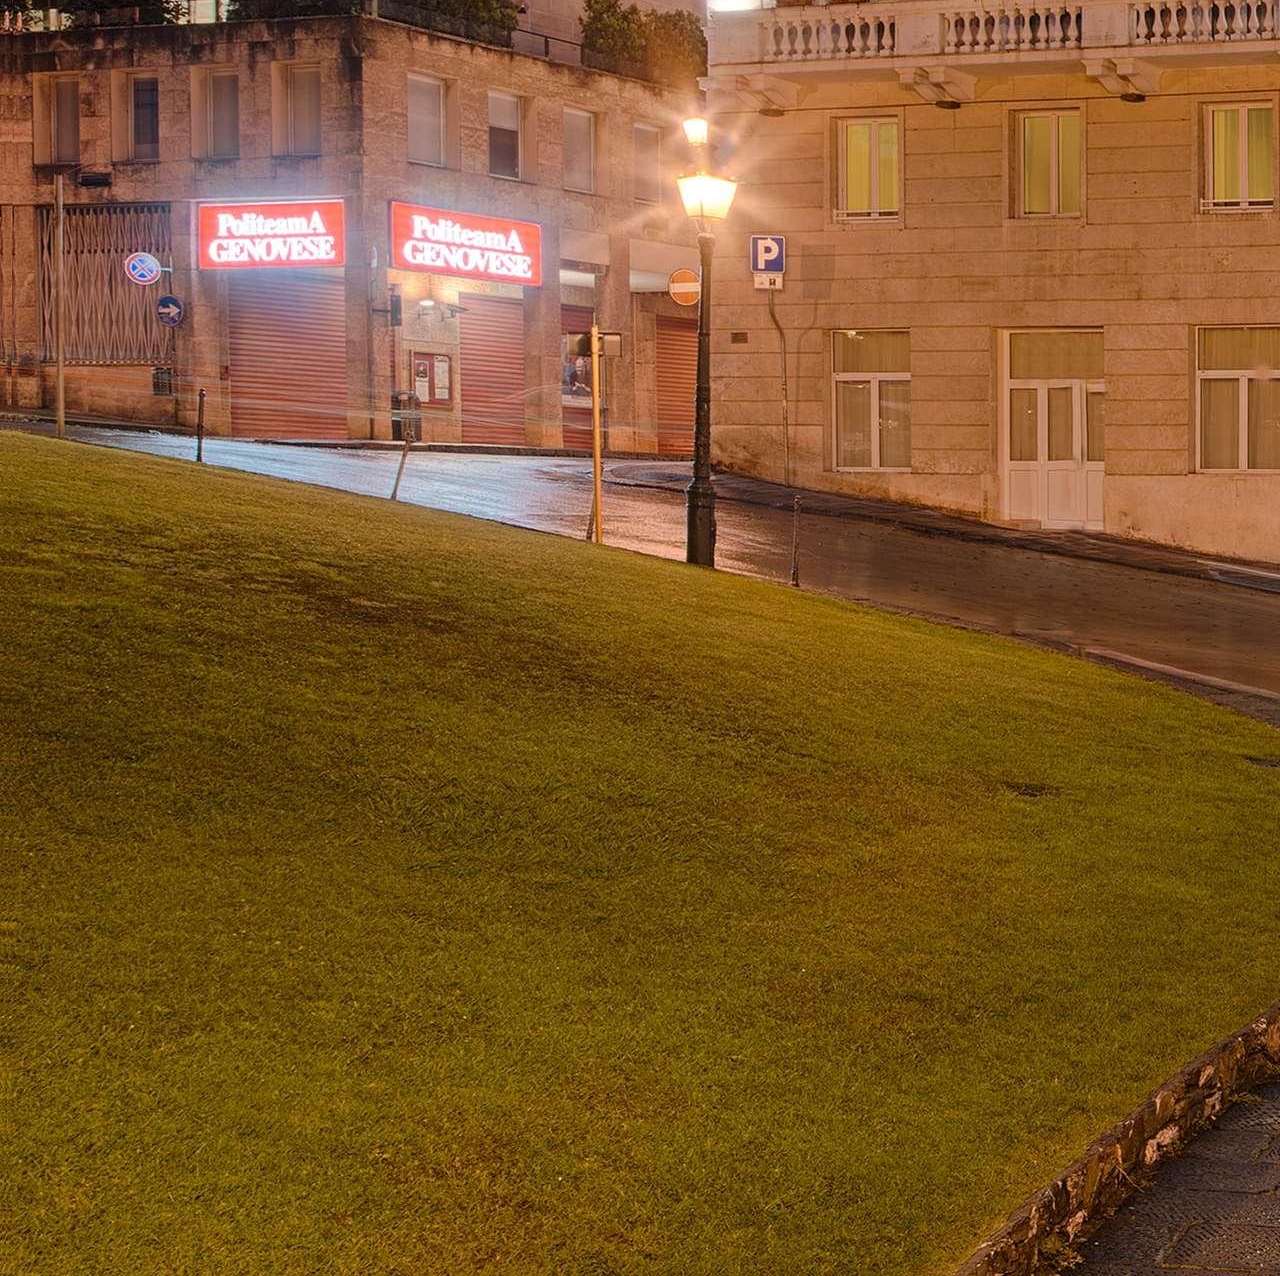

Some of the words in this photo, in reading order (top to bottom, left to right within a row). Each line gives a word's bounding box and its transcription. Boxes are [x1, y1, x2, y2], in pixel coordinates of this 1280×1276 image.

[208, 235, 337, 263] GENOVESE
[402, 239, 532, 279] GENOVESE
[757, 237, 780, 270] P
